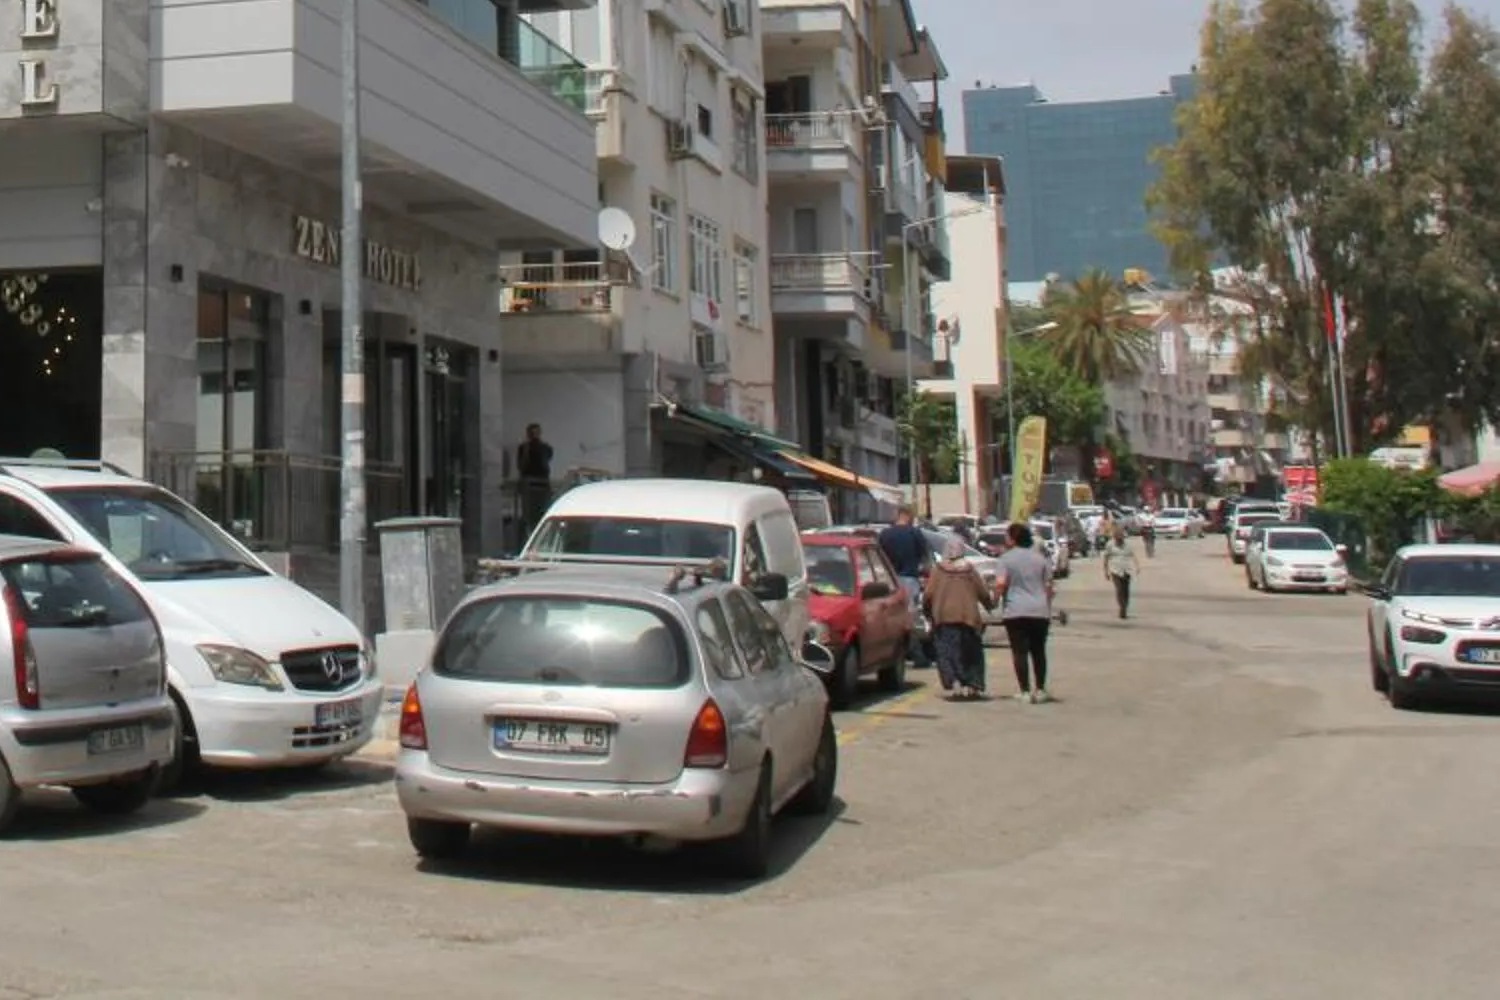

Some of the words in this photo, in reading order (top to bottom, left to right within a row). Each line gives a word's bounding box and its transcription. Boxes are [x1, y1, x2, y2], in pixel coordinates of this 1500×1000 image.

[296, 215, 343, 265] ZEN
[507, 721, 527, 741] 07
[537, 723, 569, 744] FRK
